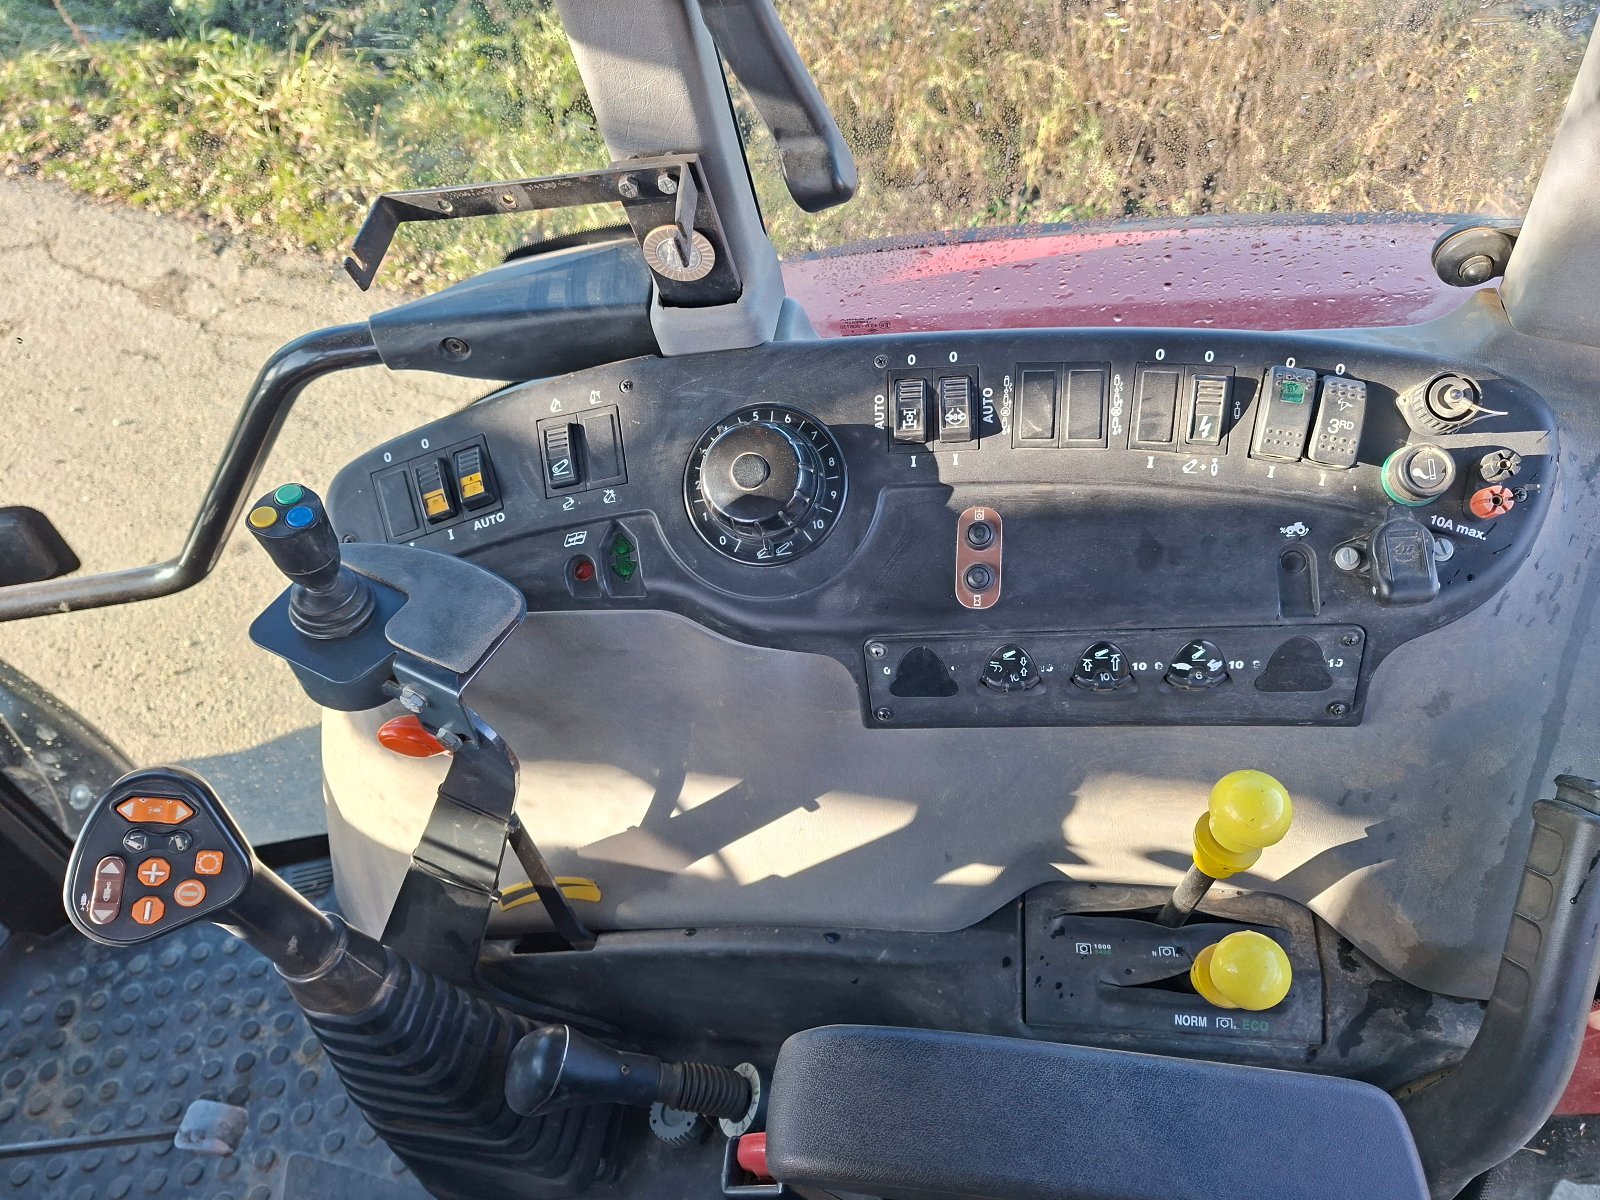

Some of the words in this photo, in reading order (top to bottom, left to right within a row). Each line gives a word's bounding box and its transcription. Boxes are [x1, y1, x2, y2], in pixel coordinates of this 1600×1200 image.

[907, 354, 916, 365] 0
[949, 351, 958, 363] 0
[1155, 349, 1165, 361] 0
[1204, 351, 1214, 363] 0
[1286, 357, 1296, 369] 0
[1335, 363, 1346, 375] 0
[982, 387, 994, 424] AUTO
[752, 411, 760, 421] 5
[874, 394, 885, 430] AUTO
[784, 414, 792, 424] 6
[1327, 418, 1355, 434] 3RD
[421, 438, 429, 449] 0
[384, 452, 392, 463] 0
[828, 457, 836, 467] 8
[830, 490, 837, 499] 9
[473, 512, 506, 531] AUTO
[812, 519, 825, 529] 10
[1430, 514, 1454, 531] 10A
[1455, 523, 1487, 541] max.
[719, 536, 727, 546] 0
[1131, 662, 1147, 671] 10
[1228, 660, 1244, 670] 10
[1099, 673, 1110, 681] 10
[1195, 671, 1203, 680] 6
[1174, 1014, 1208, 1028] NORM
[1242, 1019, 1269, 1032] ECO
